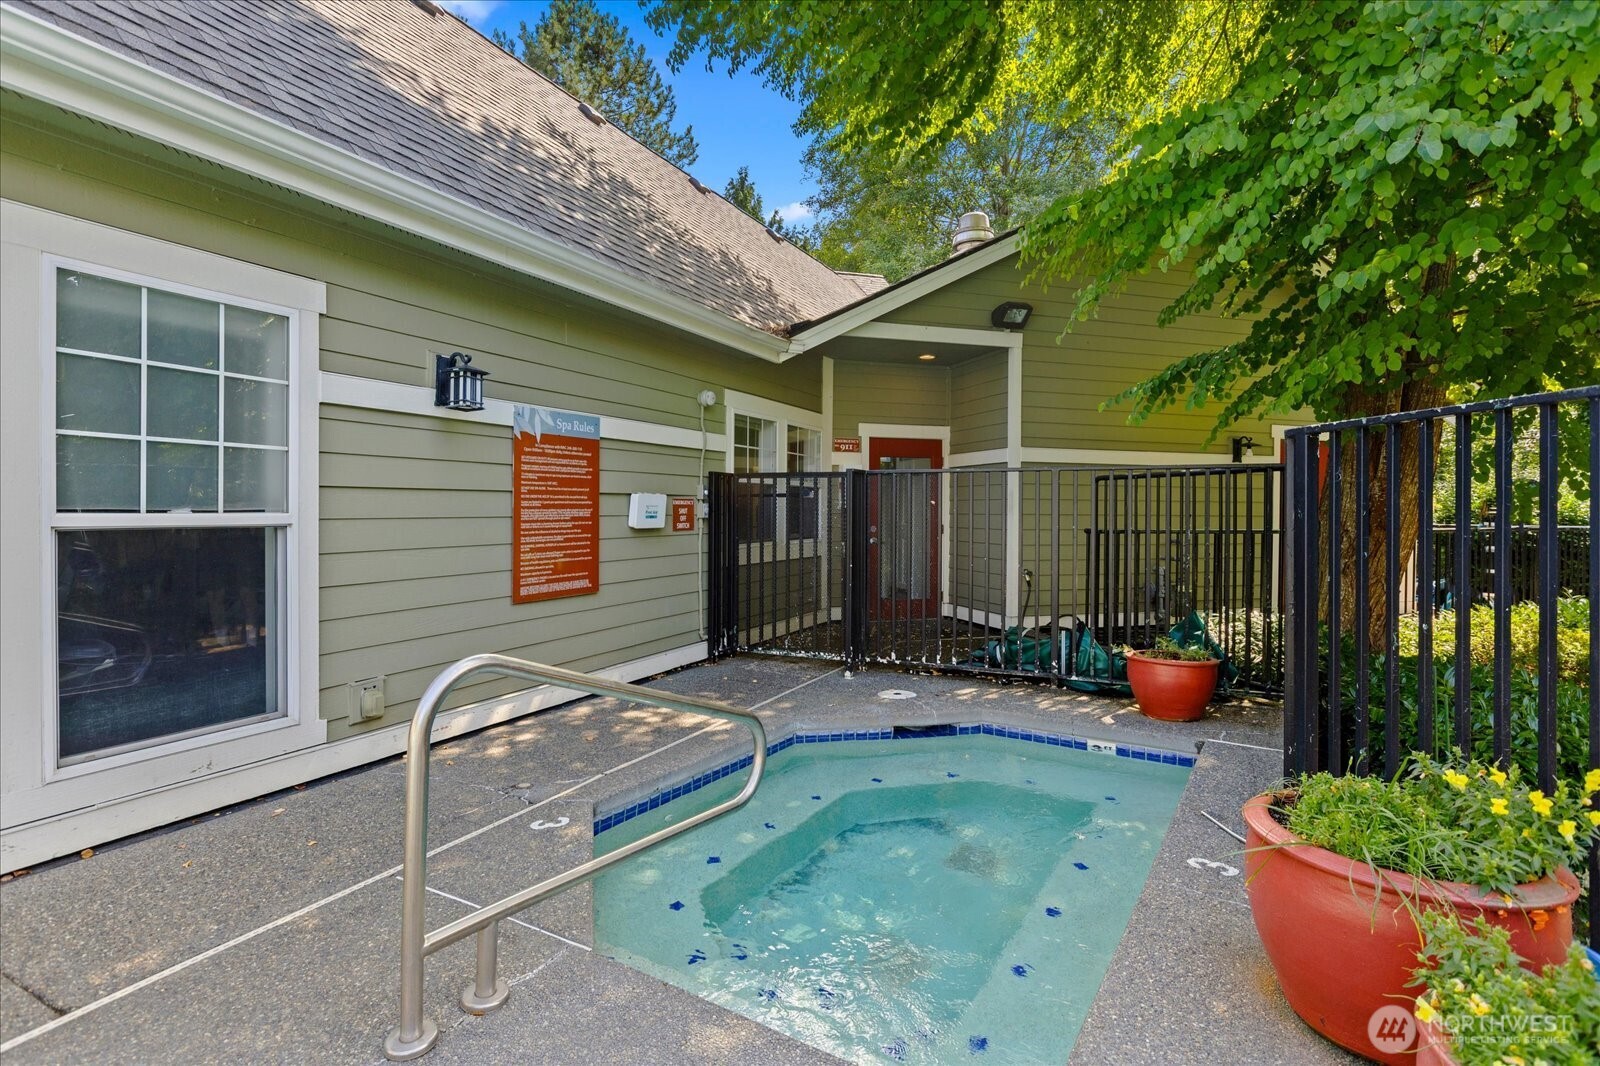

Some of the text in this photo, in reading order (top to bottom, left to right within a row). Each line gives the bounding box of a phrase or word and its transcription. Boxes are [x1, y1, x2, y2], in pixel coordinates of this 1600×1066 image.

[556, 418, 595, 433] Spa Rules
[530, 816, 570, 830] 3
[1186, 857, 1240, 877] 3
